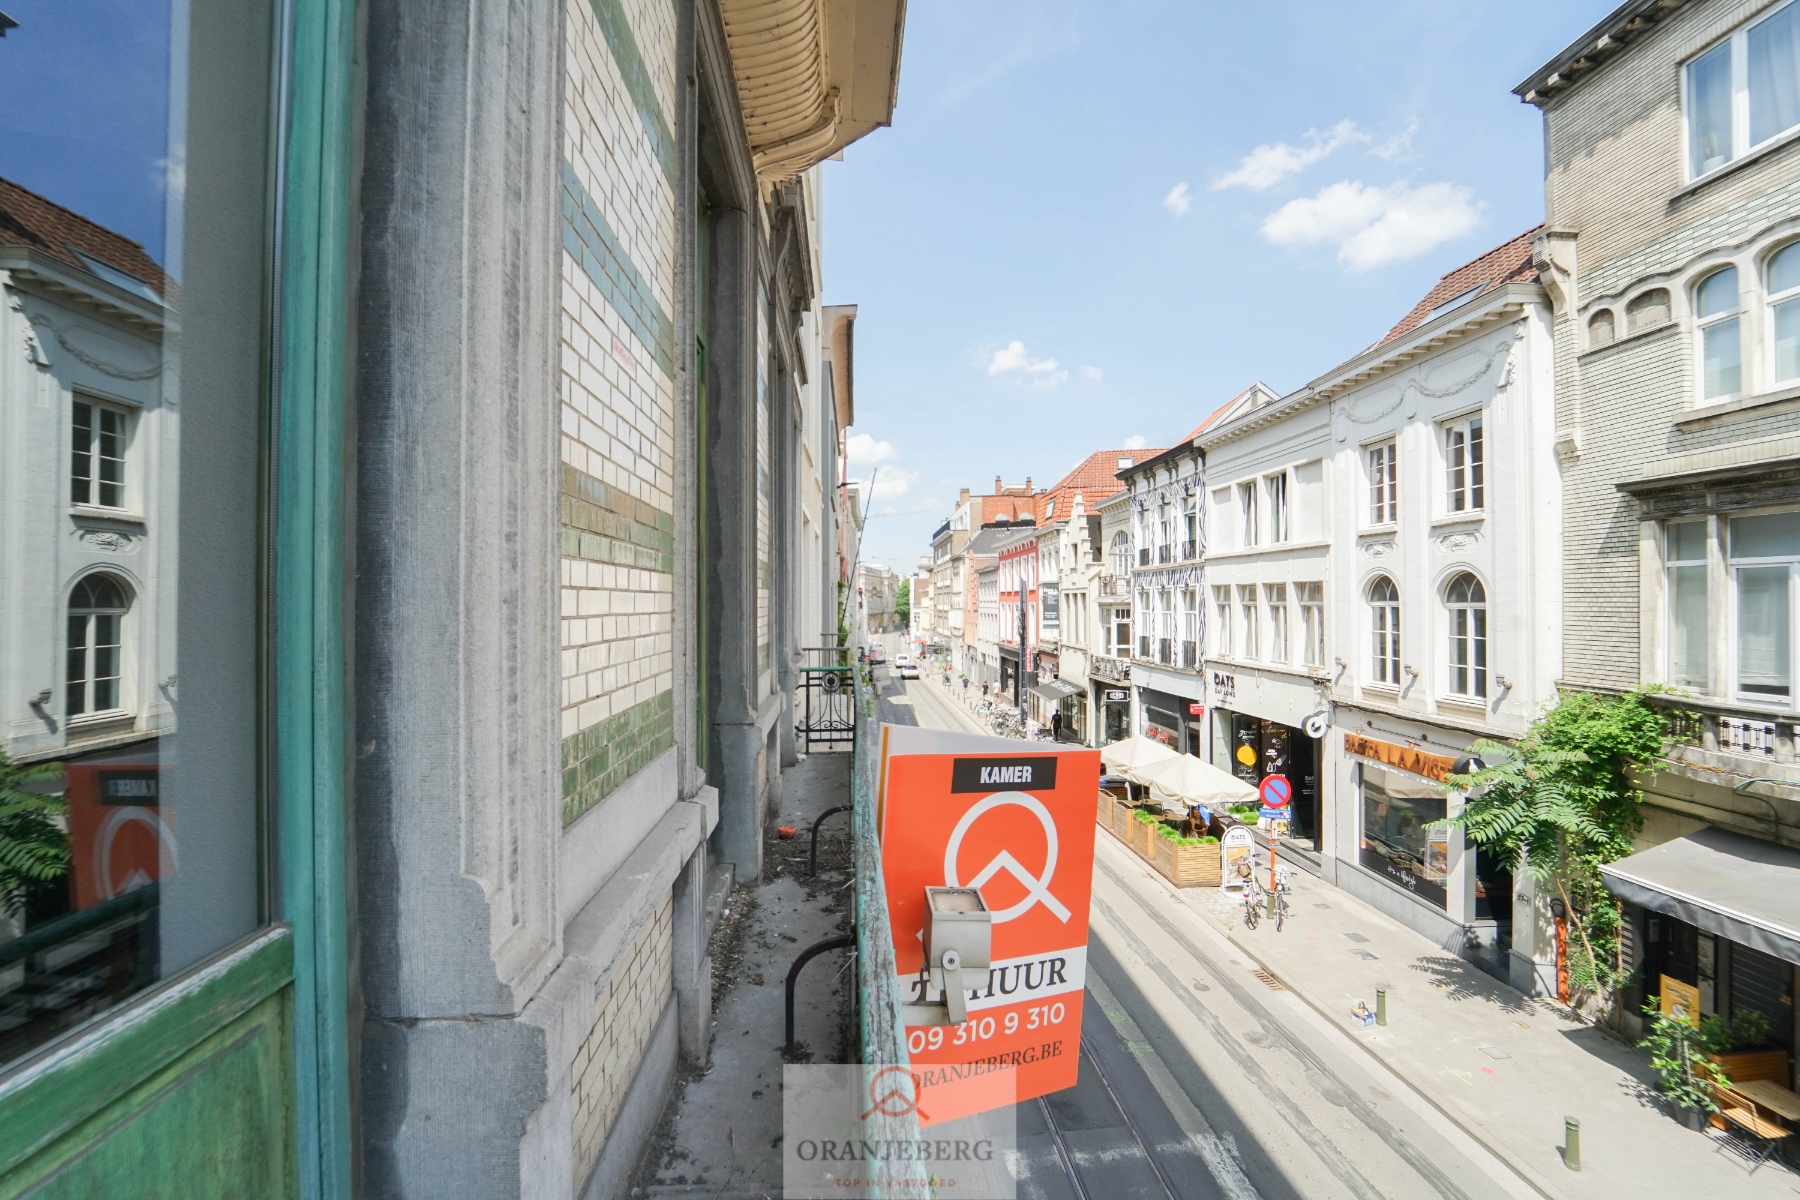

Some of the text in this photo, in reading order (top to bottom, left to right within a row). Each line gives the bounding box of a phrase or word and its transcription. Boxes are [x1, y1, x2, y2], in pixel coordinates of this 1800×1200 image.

[980, 766, 1032, 784] KAMER
[1387, 745, 1409, 771] LA
[1412, 754, 1455, 783] VIST
[908, 1002, 1065, 1054] 09 310 9 310
